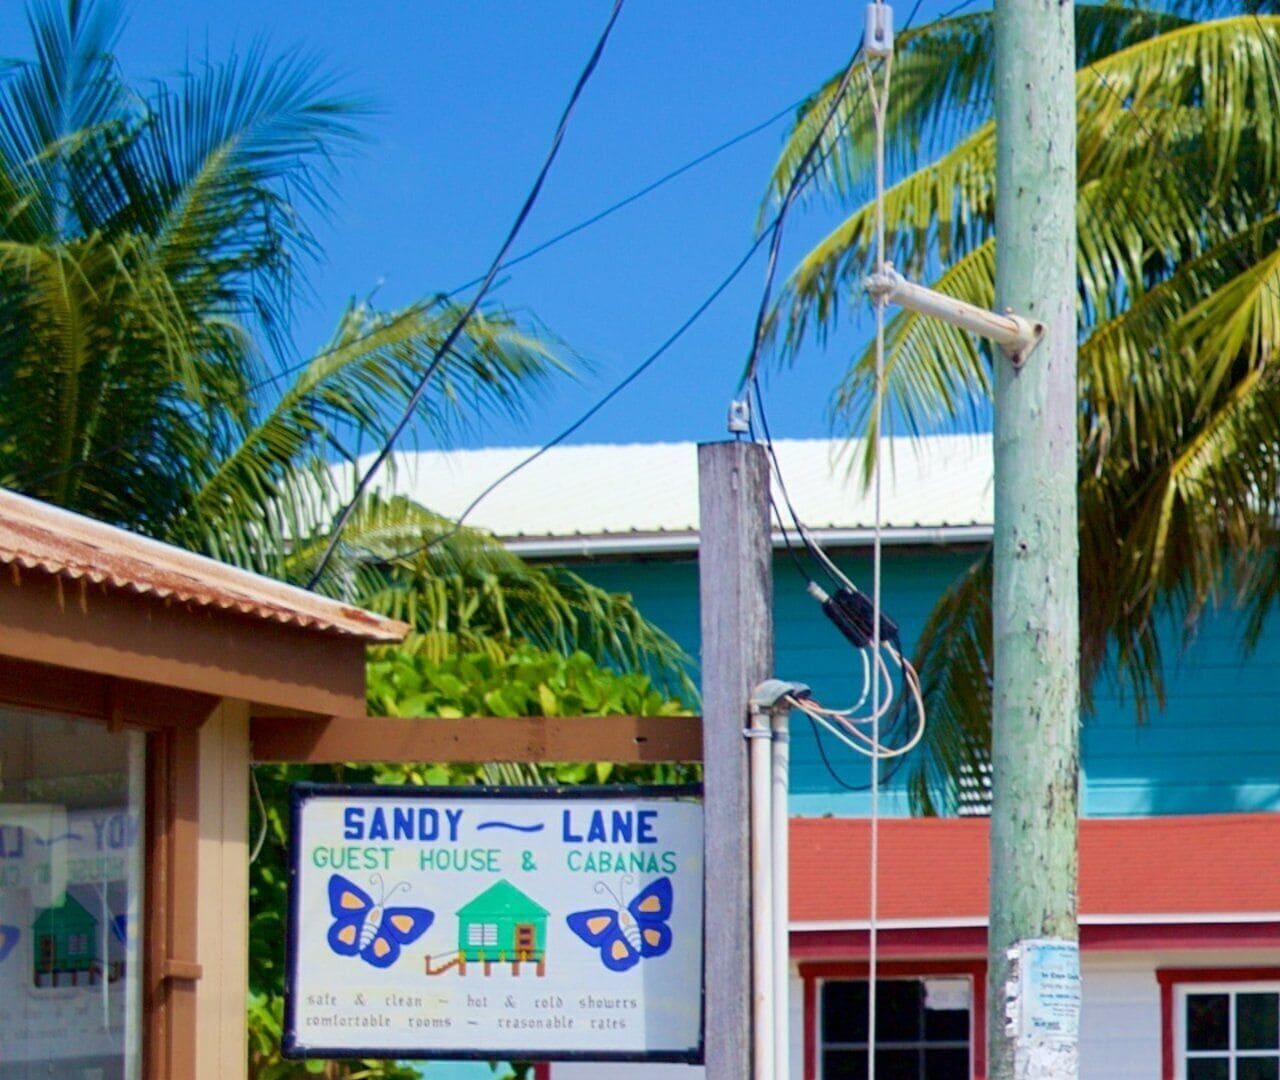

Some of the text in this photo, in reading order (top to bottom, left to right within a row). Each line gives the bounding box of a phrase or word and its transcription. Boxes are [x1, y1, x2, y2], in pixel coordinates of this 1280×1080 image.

[343, 806, 659, 844] SANDY LANE
[312, 847, 677, 874] GUEST HOUSE & CABANAS
[307, 992, 638, 1010] safe & clean hot & cold showers
[306, 1014, 627, 1031] comfortable rooms reasonable rates
